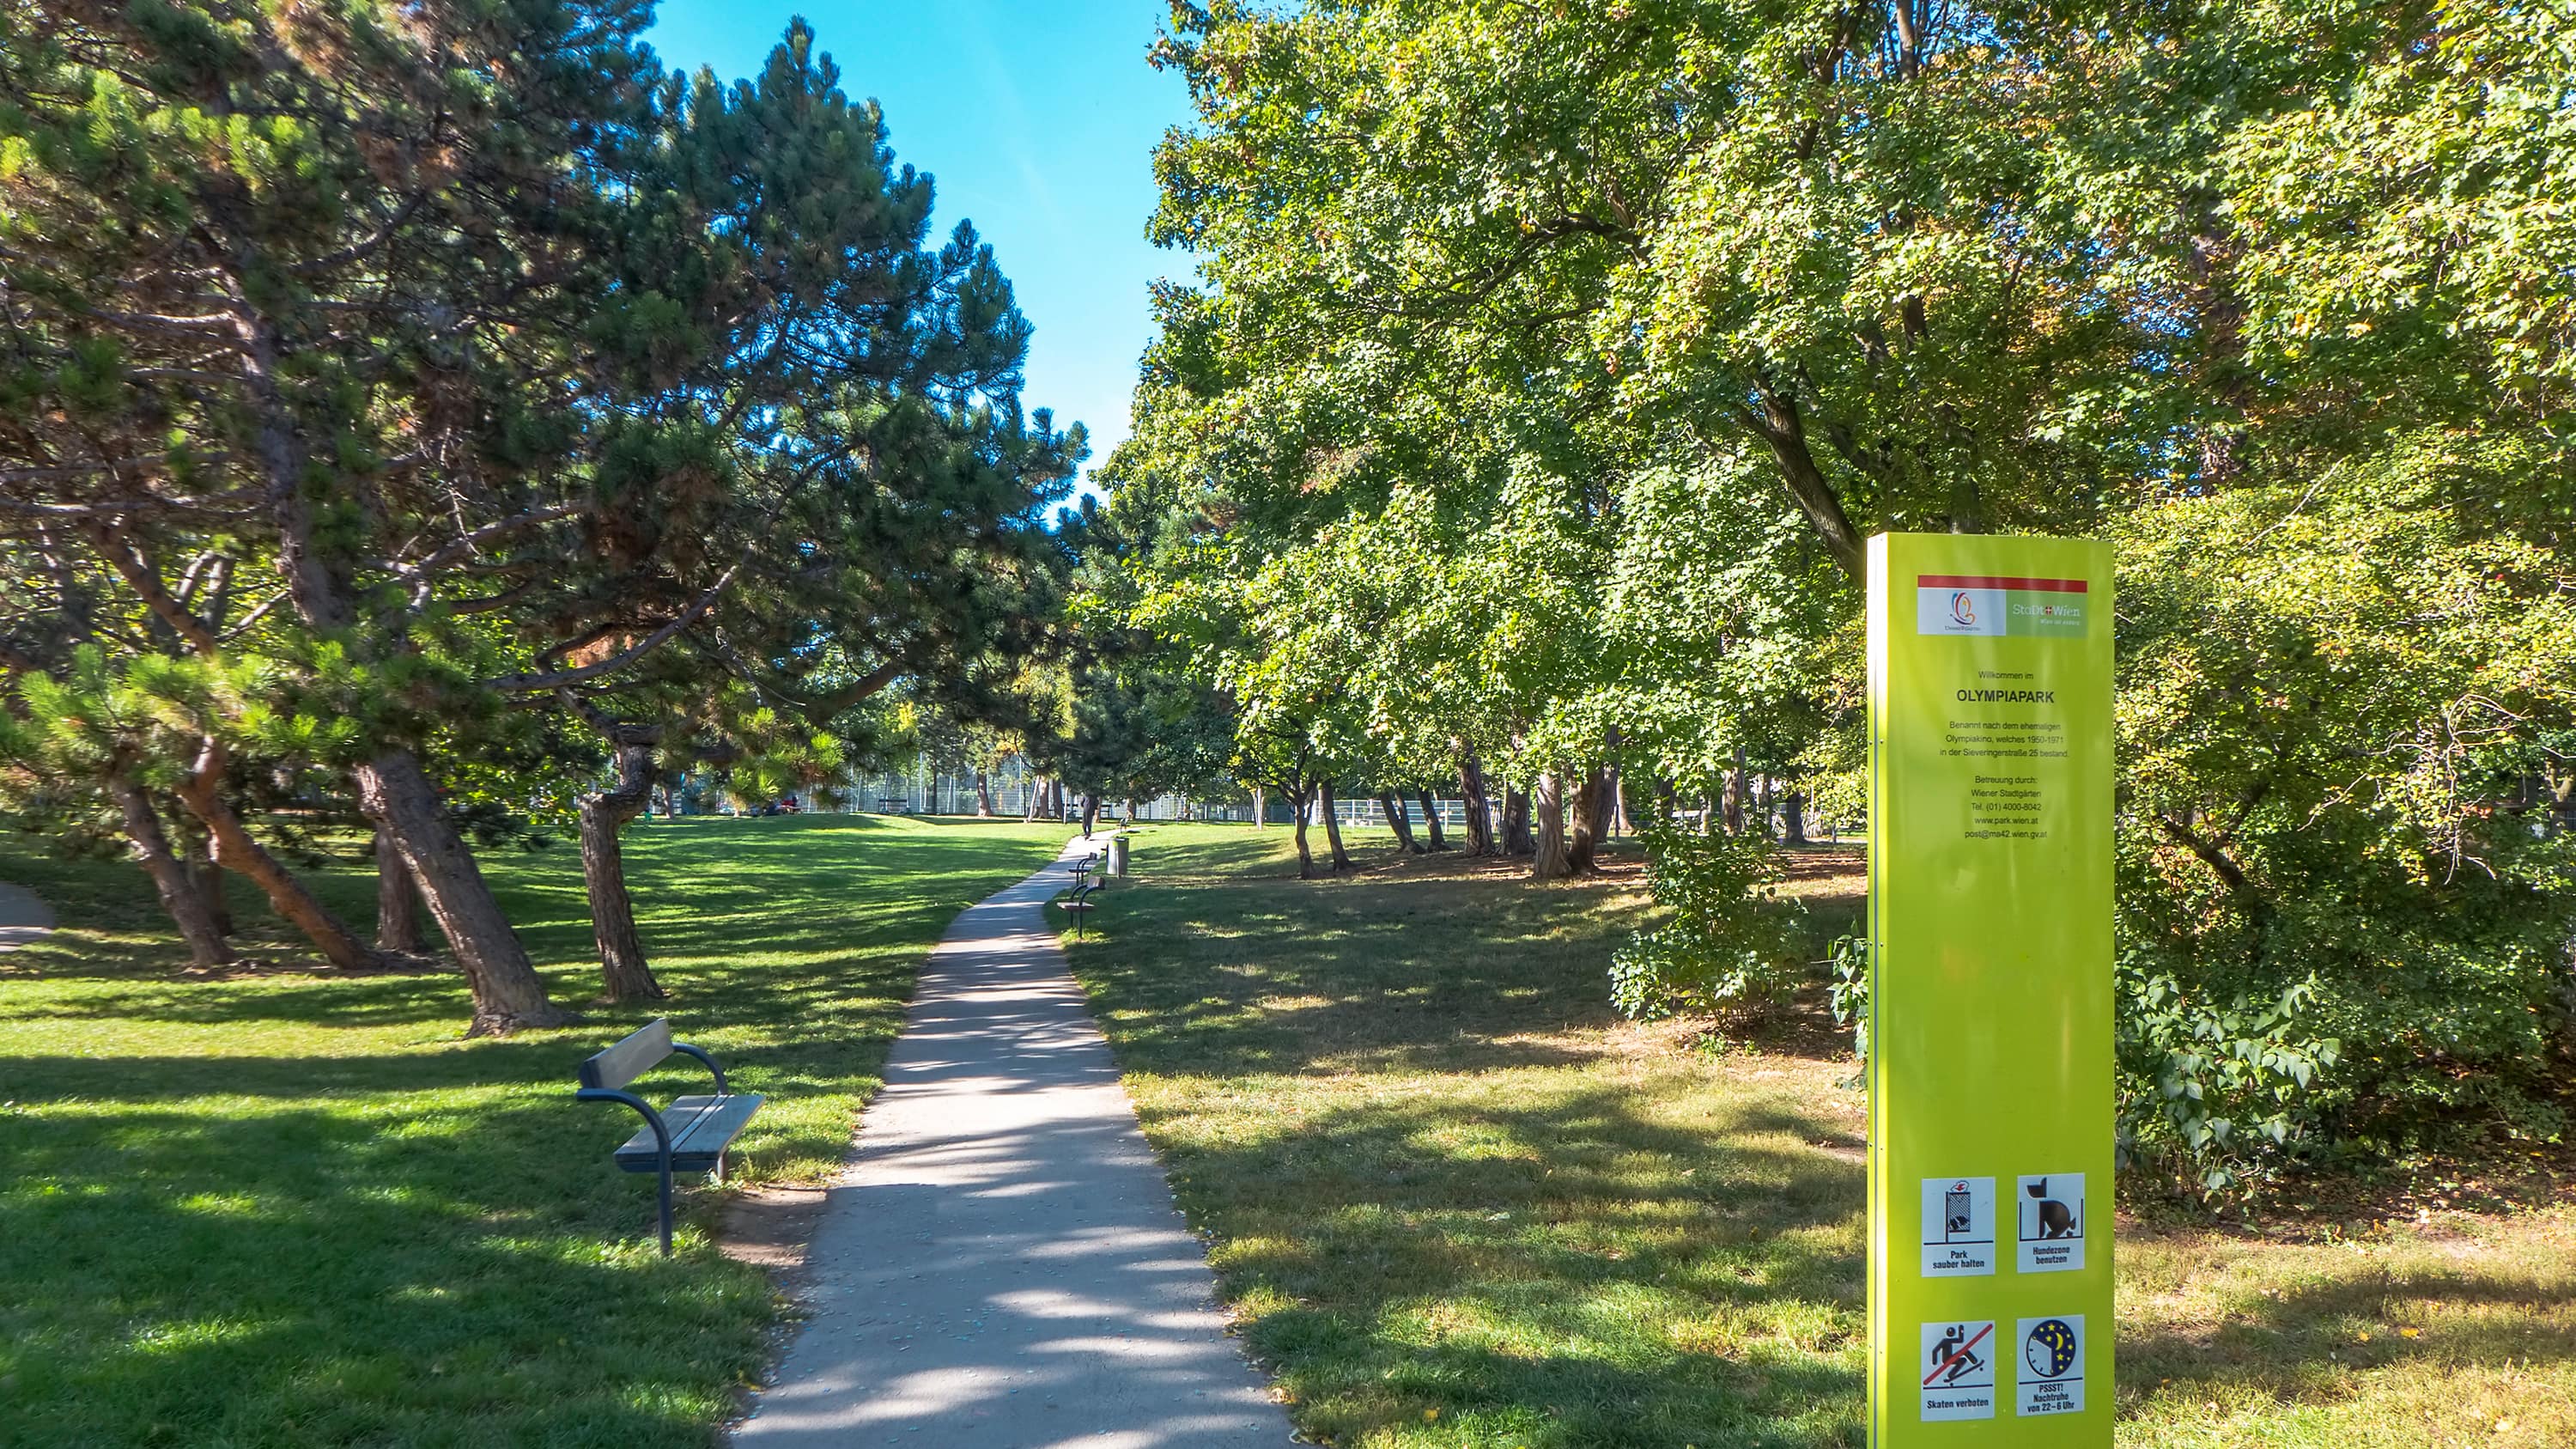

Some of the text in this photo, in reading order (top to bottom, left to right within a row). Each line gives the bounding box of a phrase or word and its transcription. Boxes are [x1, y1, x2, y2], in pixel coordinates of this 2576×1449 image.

[2053, 605, 2081, 617] Wien
[1978, 671, 2023, 679] Willkommen
[1957, 690, 2054, 703] OLYMPIAPARK
[1949, 721, 1981, 729] Benannt
[2020, 722, 2061, 732] ehemaligen
[1975, 776, 2014, 785] Betreuung
[1999, 788, 2041, 799] Stadtgärten
[1971, 802, 1984, 811] Tel.
[1986, 803, 2002, 812] (01)
[1965, 830, 2047, 839] post@ma42.wien.gv.at
[1950, 1251, 1967, 1259] Park
[2032, 1246, 2070, 1255] Hundezone
[1933, 1259, 1984, 1269] sauber halten
[2036, 1256, 2068, 1264] benutzen
[2038, 1384, 2063, 1393] PSSST!
[2033, 1392, 2069, 1403] Nachtruhe
[1927, 1398, 1990, 1409] Skaten verboten
[2027, 1404, 2040, 1413] von
[2063, 1400, 2075, 1409] Uhr
